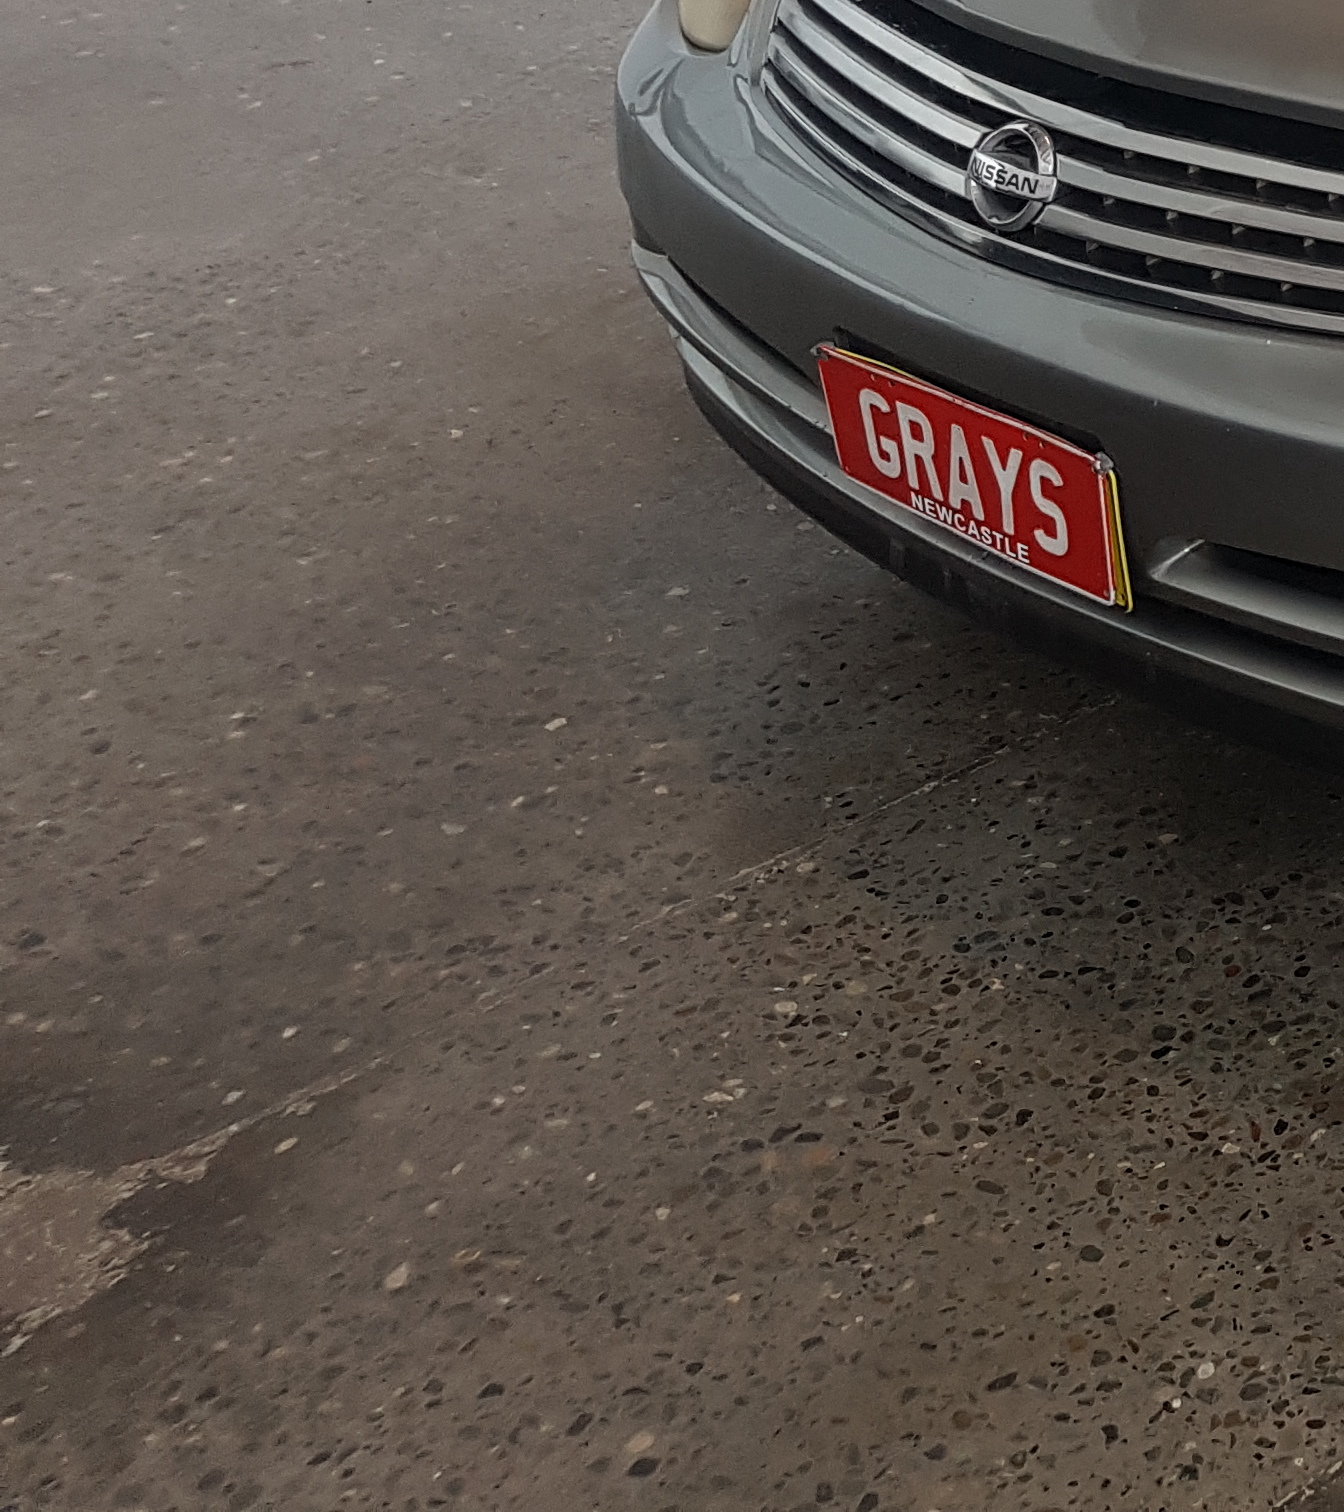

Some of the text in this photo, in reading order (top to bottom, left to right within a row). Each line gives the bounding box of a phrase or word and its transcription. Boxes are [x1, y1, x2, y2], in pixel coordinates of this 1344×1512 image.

[970, 156, 1039, 194] NISSAN
[858, 388, 1068, 556] GRAYS
[910, 491, 1030, 563] NEWCASTLE
